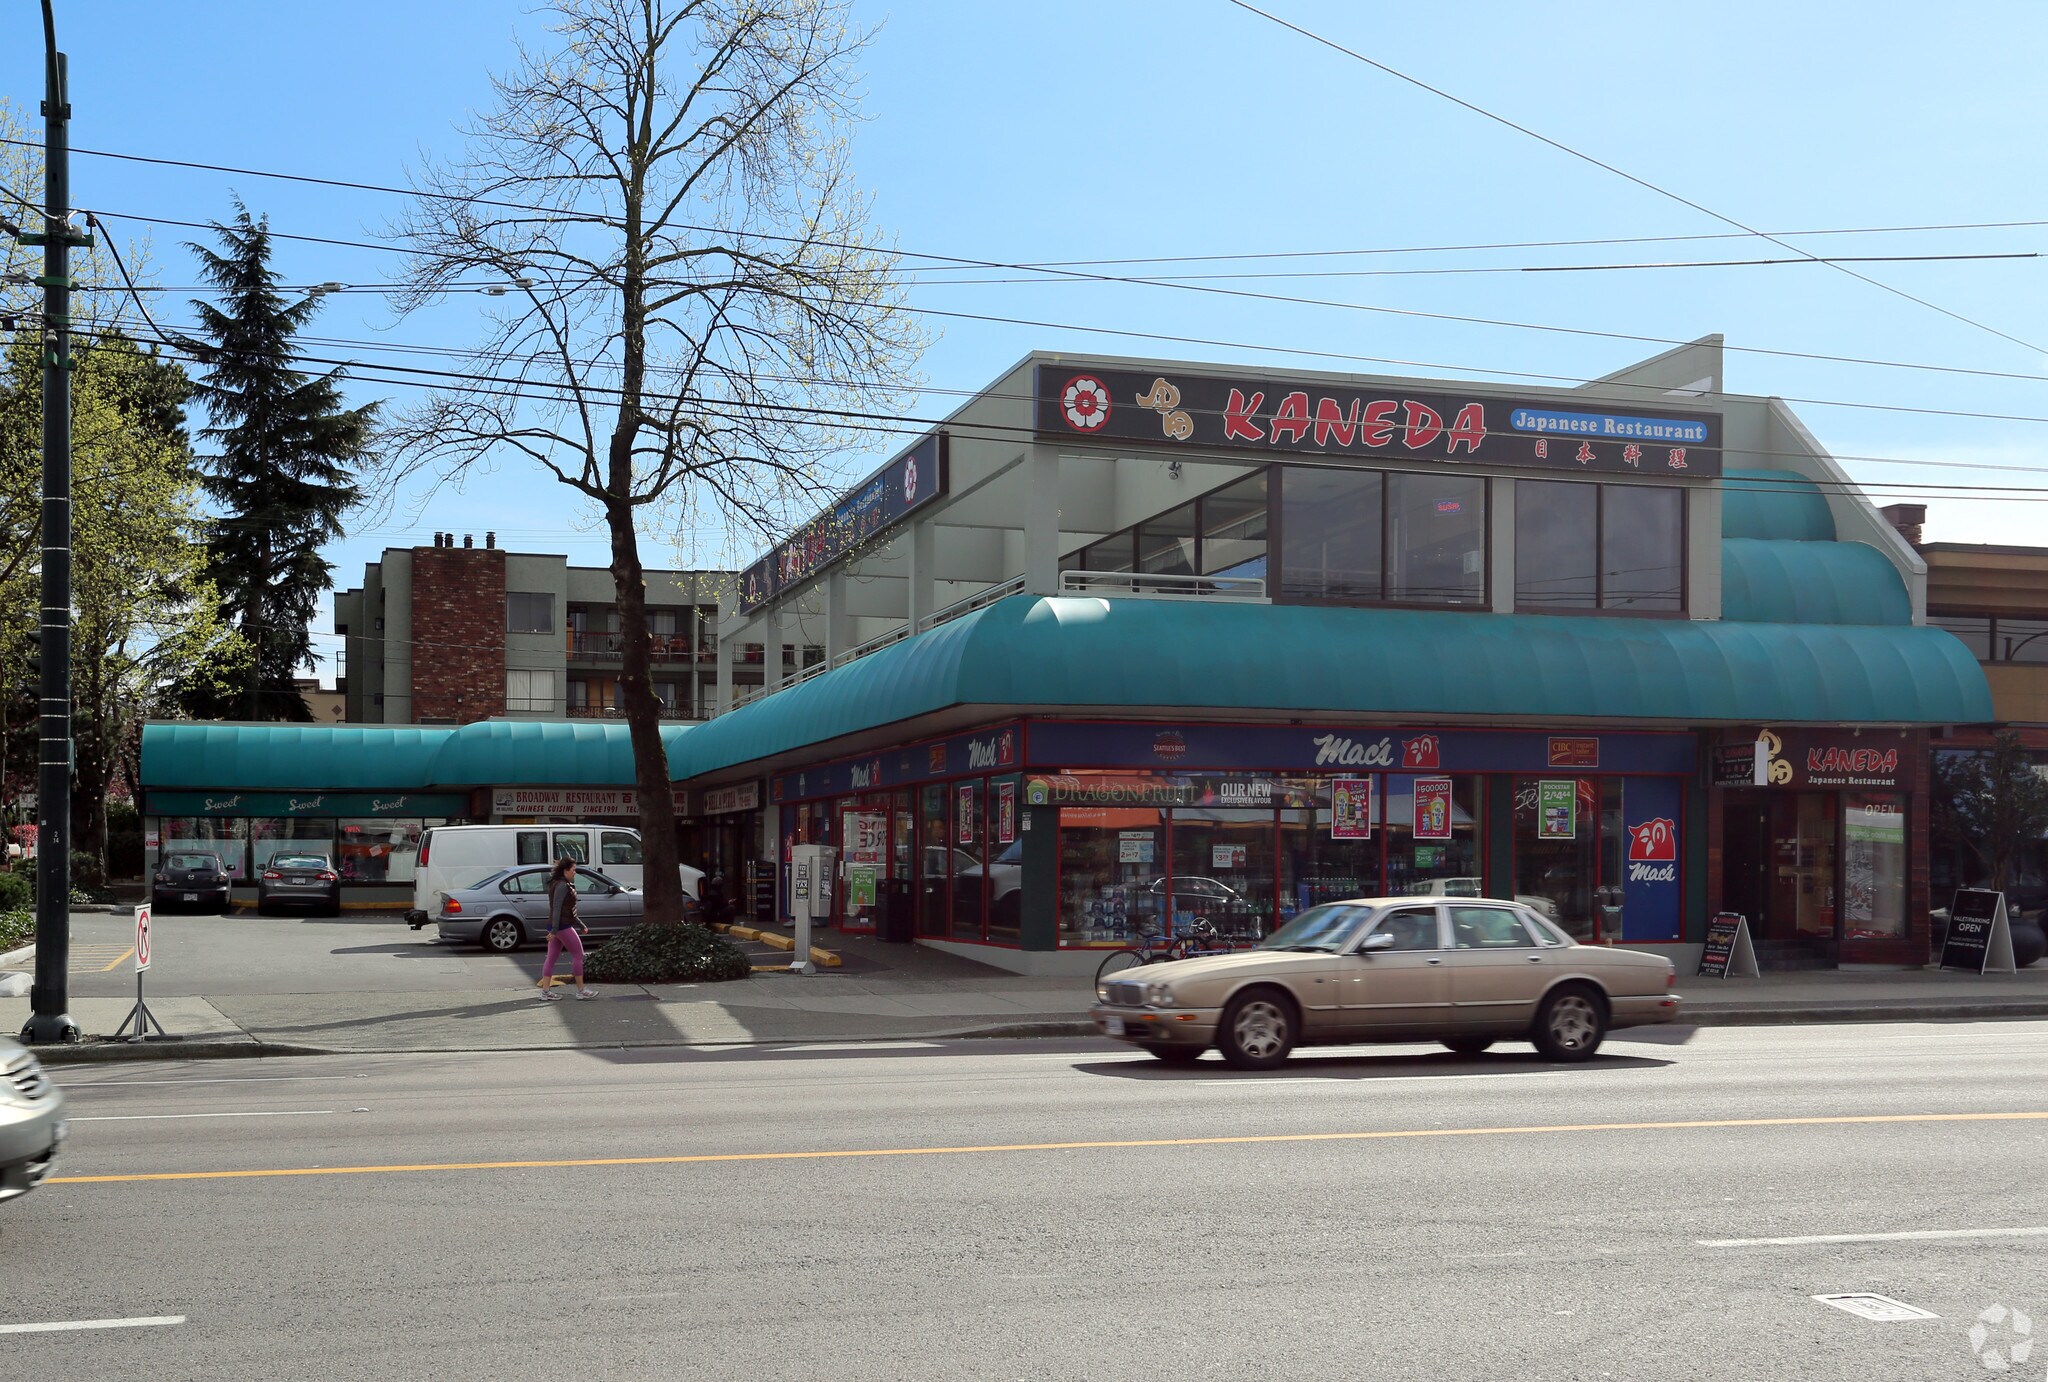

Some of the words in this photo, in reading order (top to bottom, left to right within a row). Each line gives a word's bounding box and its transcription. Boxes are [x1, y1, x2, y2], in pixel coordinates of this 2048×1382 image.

[1223, 388, 1488, 453] KANEDA
[1516, 412, 1598, 432] Japanese
[1604, 418, 1703, 440] Restaurant
[1534, 438, 1688, 468] 日本料理
[1313, 733, 1394, 766] Mac's
[1552, 742, 1571, 751] CIBC
[968, 737, 997, 771] Mac's
[1807, 747, 1898, 773] KANEDA
[1808, 776, 1846, 786] Japanese
[1848, 776, 1896, 786] Restaurant
[1221, 783, 1246, 797] OUR
[1247, 783, 1272, 797] NEW
[1351, 793, 1365, 801] WIN
[516, 791, 560, 803] BROADWAY
[566, 792, 616, 804] RESTAURANT
[516, 805, 545, 813] CHINESE
[1865, 804, 1896, 816] OPEN
[1628, 862, 1676, 882] Mac's
[1958, 923, 1982, 933] OPEN
